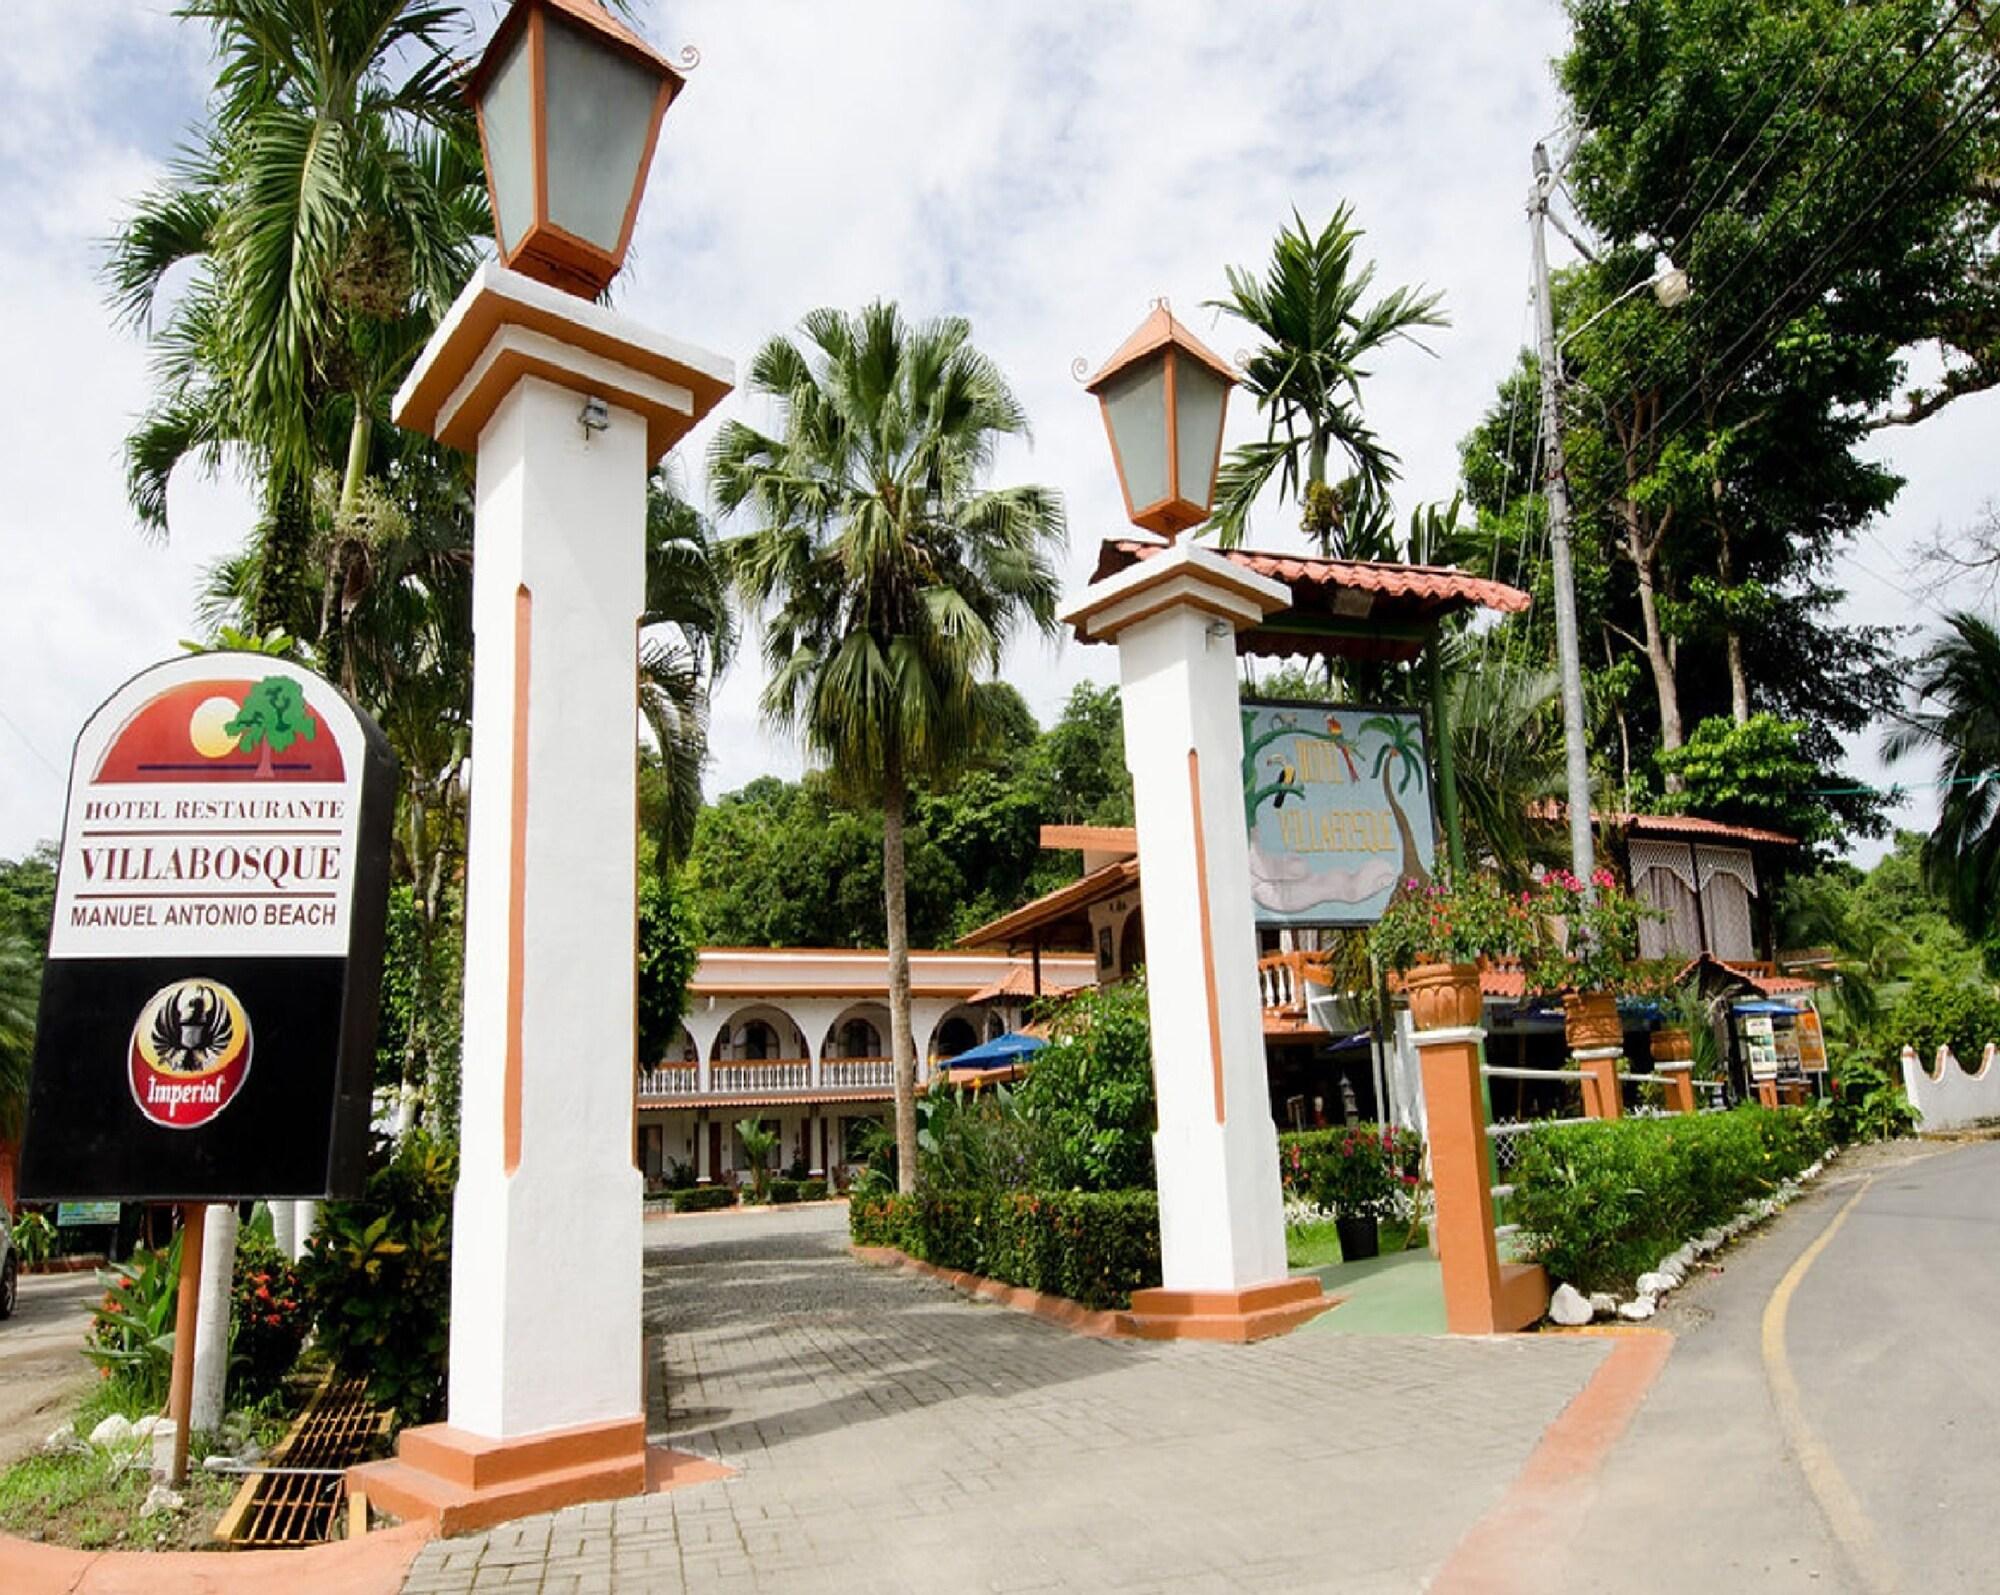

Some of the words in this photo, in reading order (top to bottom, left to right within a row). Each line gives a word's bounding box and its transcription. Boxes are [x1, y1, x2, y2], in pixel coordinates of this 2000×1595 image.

[84, 800, 168, 821] HOTEL
[174, 799, 345, 820] RESTAURANTE
[81, 845, 342, 889] VILLABOSQUE
[71, 904, 158, 927] MANUEL
[164, 903, 258, 926] ANTONIO
[263, 903, 337, 926] BEACH
[147, 1075, 225, 1118] Imperial
